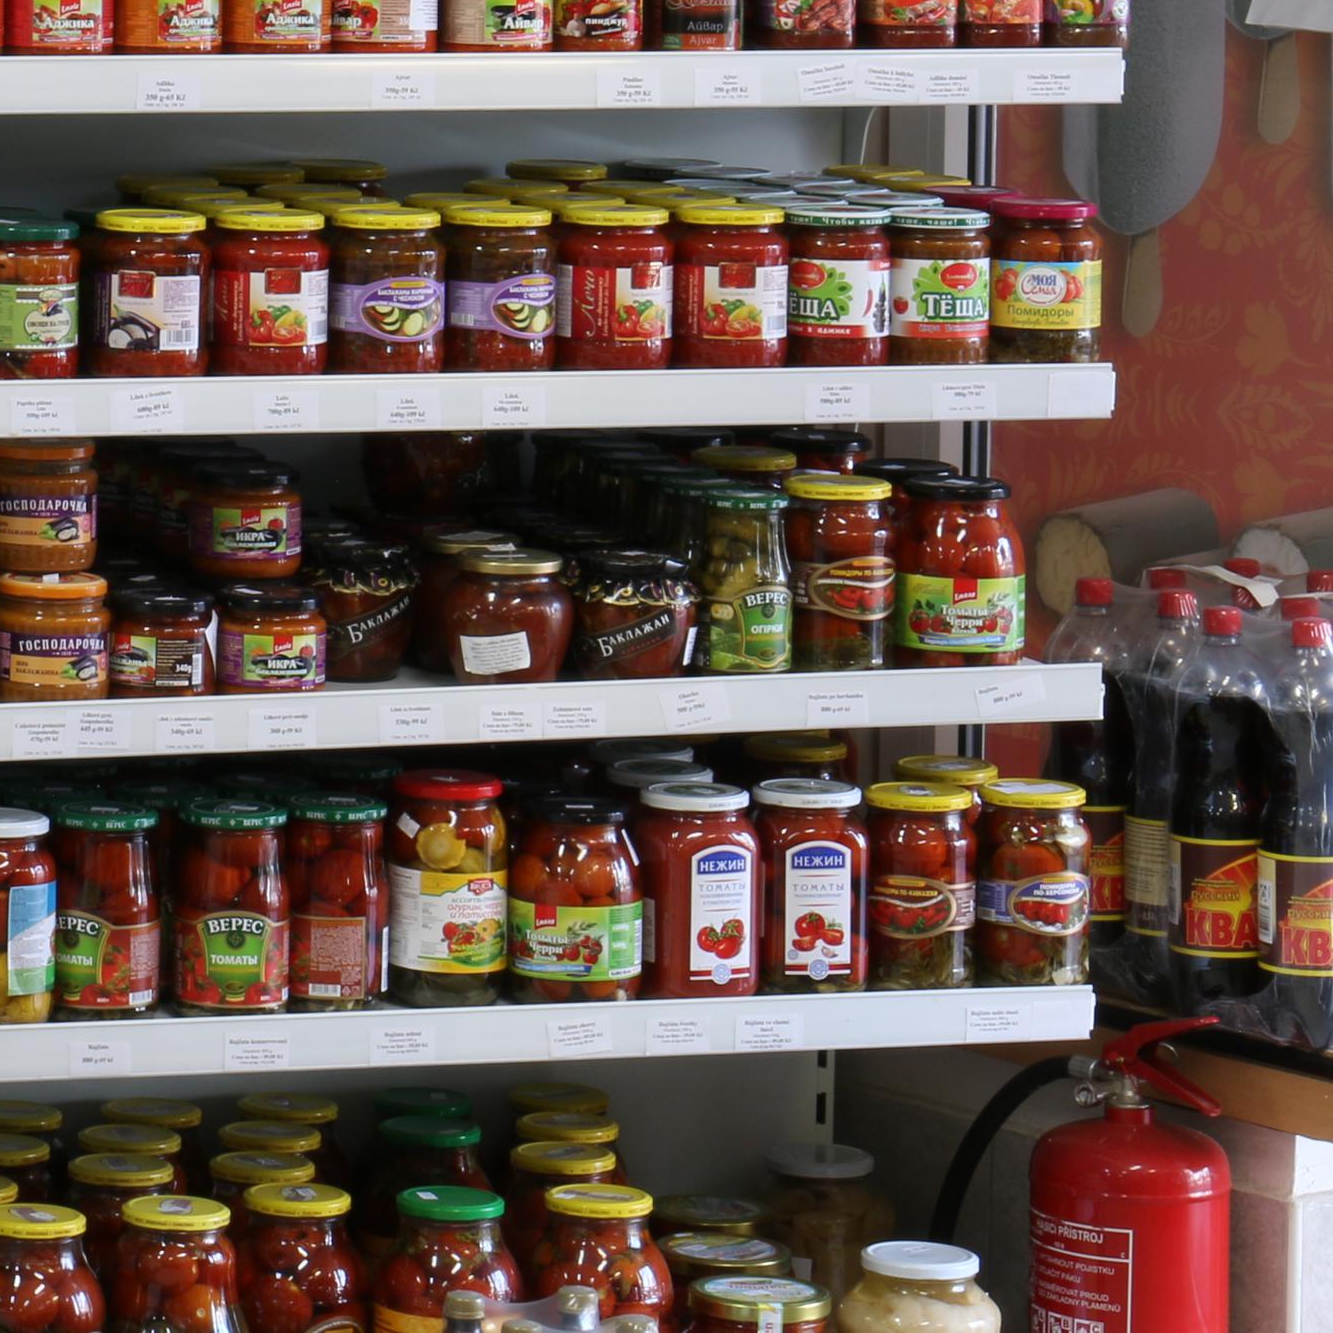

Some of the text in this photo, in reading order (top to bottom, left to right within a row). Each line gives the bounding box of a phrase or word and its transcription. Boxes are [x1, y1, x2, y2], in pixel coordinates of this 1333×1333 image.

[687, 20, 724, 32] Айвар
[689, 35, 717, 46] Ajvar
[1031, 274, 1057, 286] МОЯ
[1007, 305, 1074, 319] Помидоры
[0, 499, 87, 513] ГОСПОДАРОЧКА
[235, 531, 266, 543] ИКРА
[597, 610, 672, 658] БАКЛАЖАН
[751, 623, 783, 636] ОГІРКИ
[699, 859, 746, 873] НЕЖИН
[697, 882, 747, 892] ТОМАТЫ
[210, 953, 258, 966] ТОМАТЫ
[1058, 1225, 1104, 1244] PŘÍSTROJ
